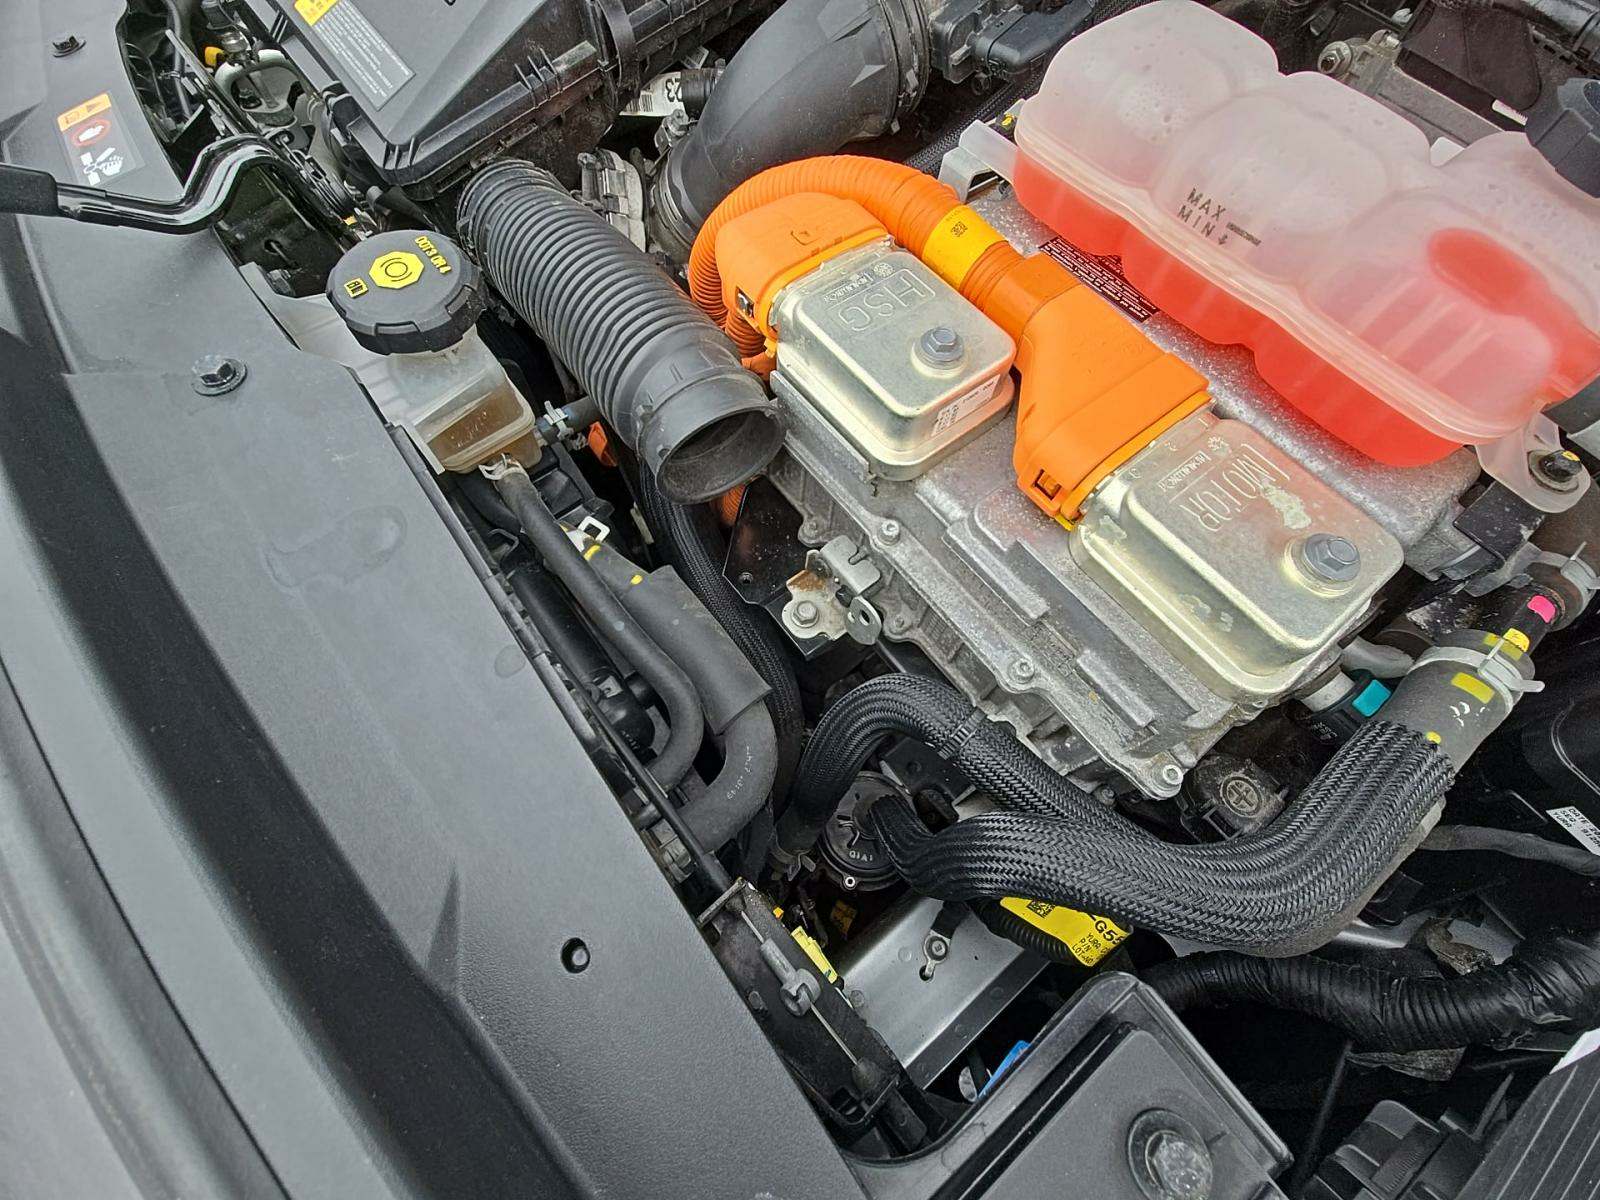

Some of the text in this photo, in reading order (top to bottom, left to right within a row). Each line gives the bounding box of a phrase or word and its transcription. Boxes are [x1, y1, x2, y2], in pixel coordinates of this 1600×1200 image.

[1186, 187, 1226, 221] MAX
[1177, 205, 1216, 238] MIN
[838, 275, 925, 331] HSG
[1179, 453, 1277, 532] MOTOR
[1079, 937, 1092, 952] P/N
[1087, 932, 1101, 950] YURA
